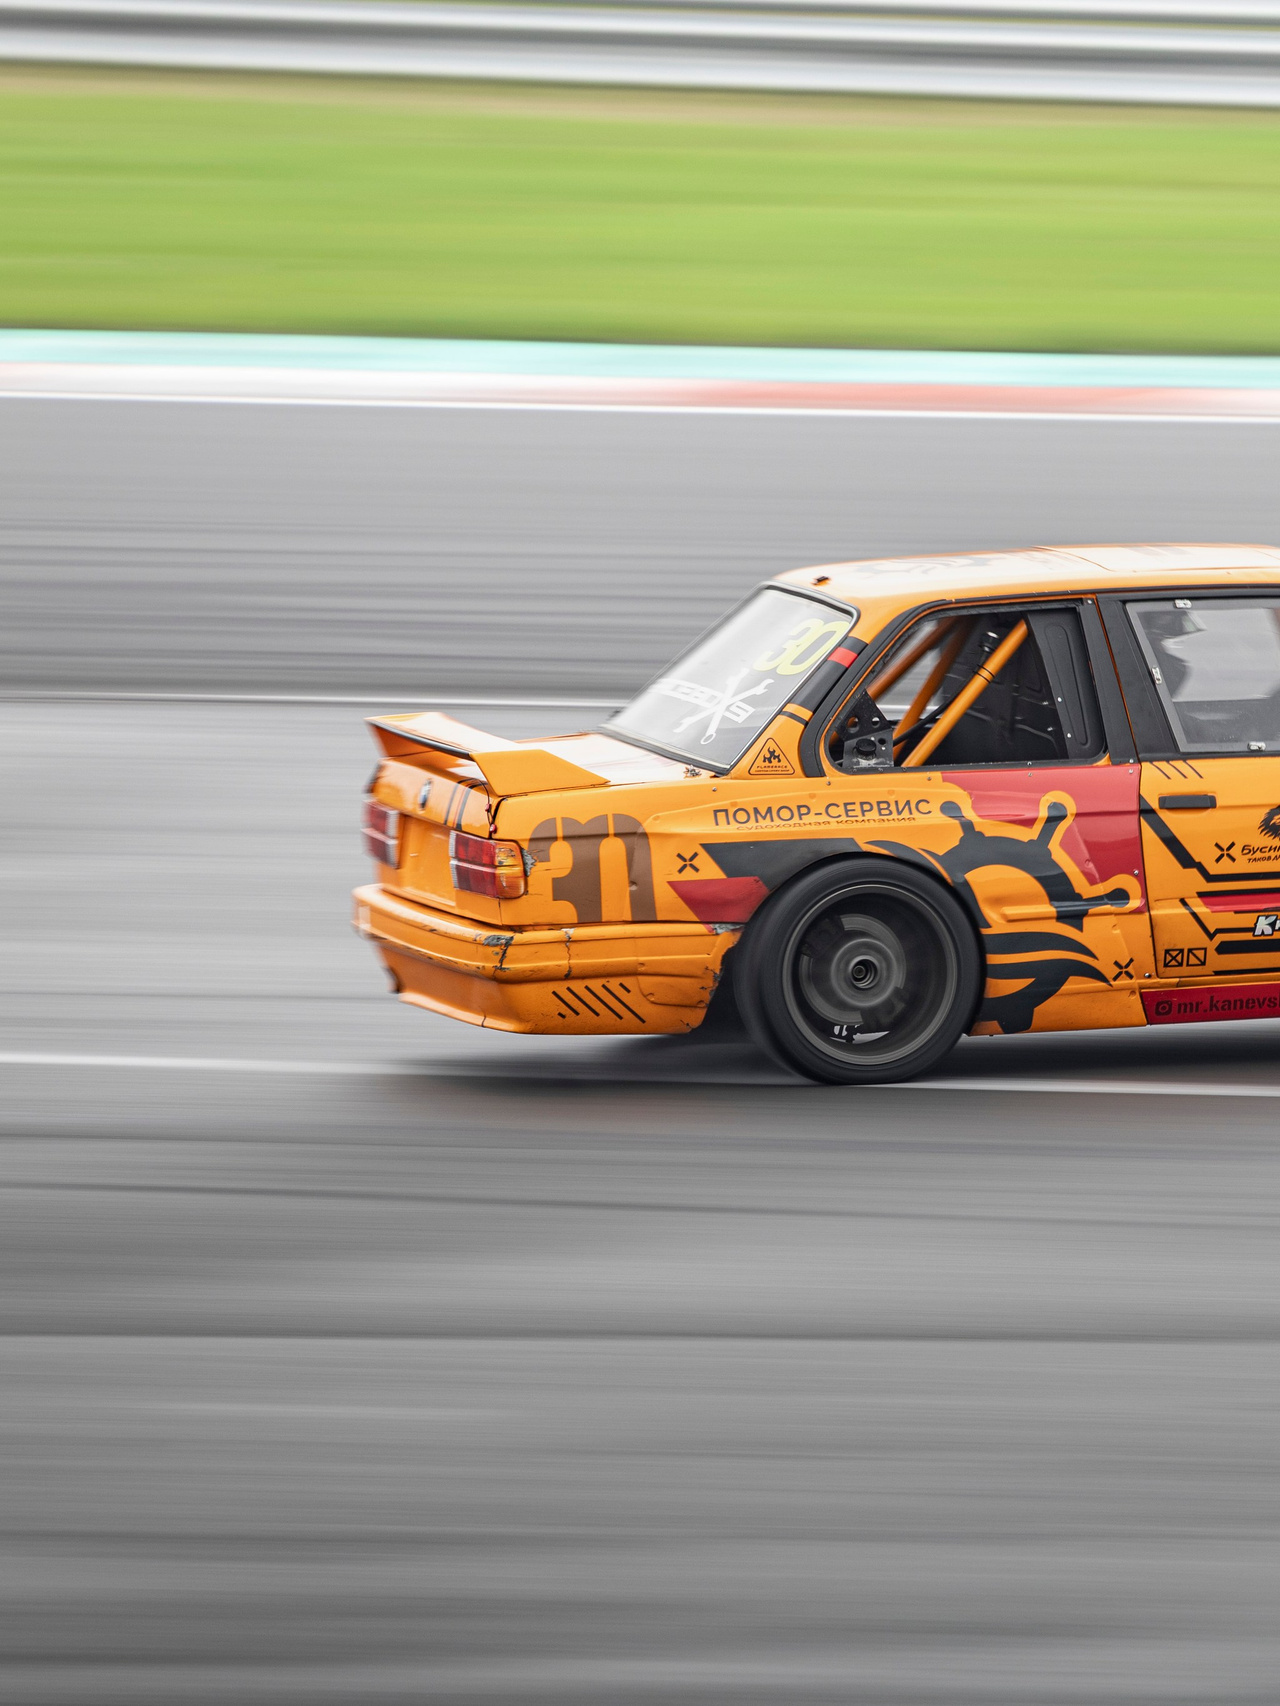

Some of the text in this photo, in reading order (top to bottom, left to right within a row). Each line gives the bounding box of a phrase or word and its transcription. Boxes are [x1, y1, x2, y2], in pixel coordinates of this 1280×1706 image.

[753, 618, 849, 675] 30
[713, 799, 932, 827] ПОМОР-СЕРВИС
[836, 816, 916, 825] компания
